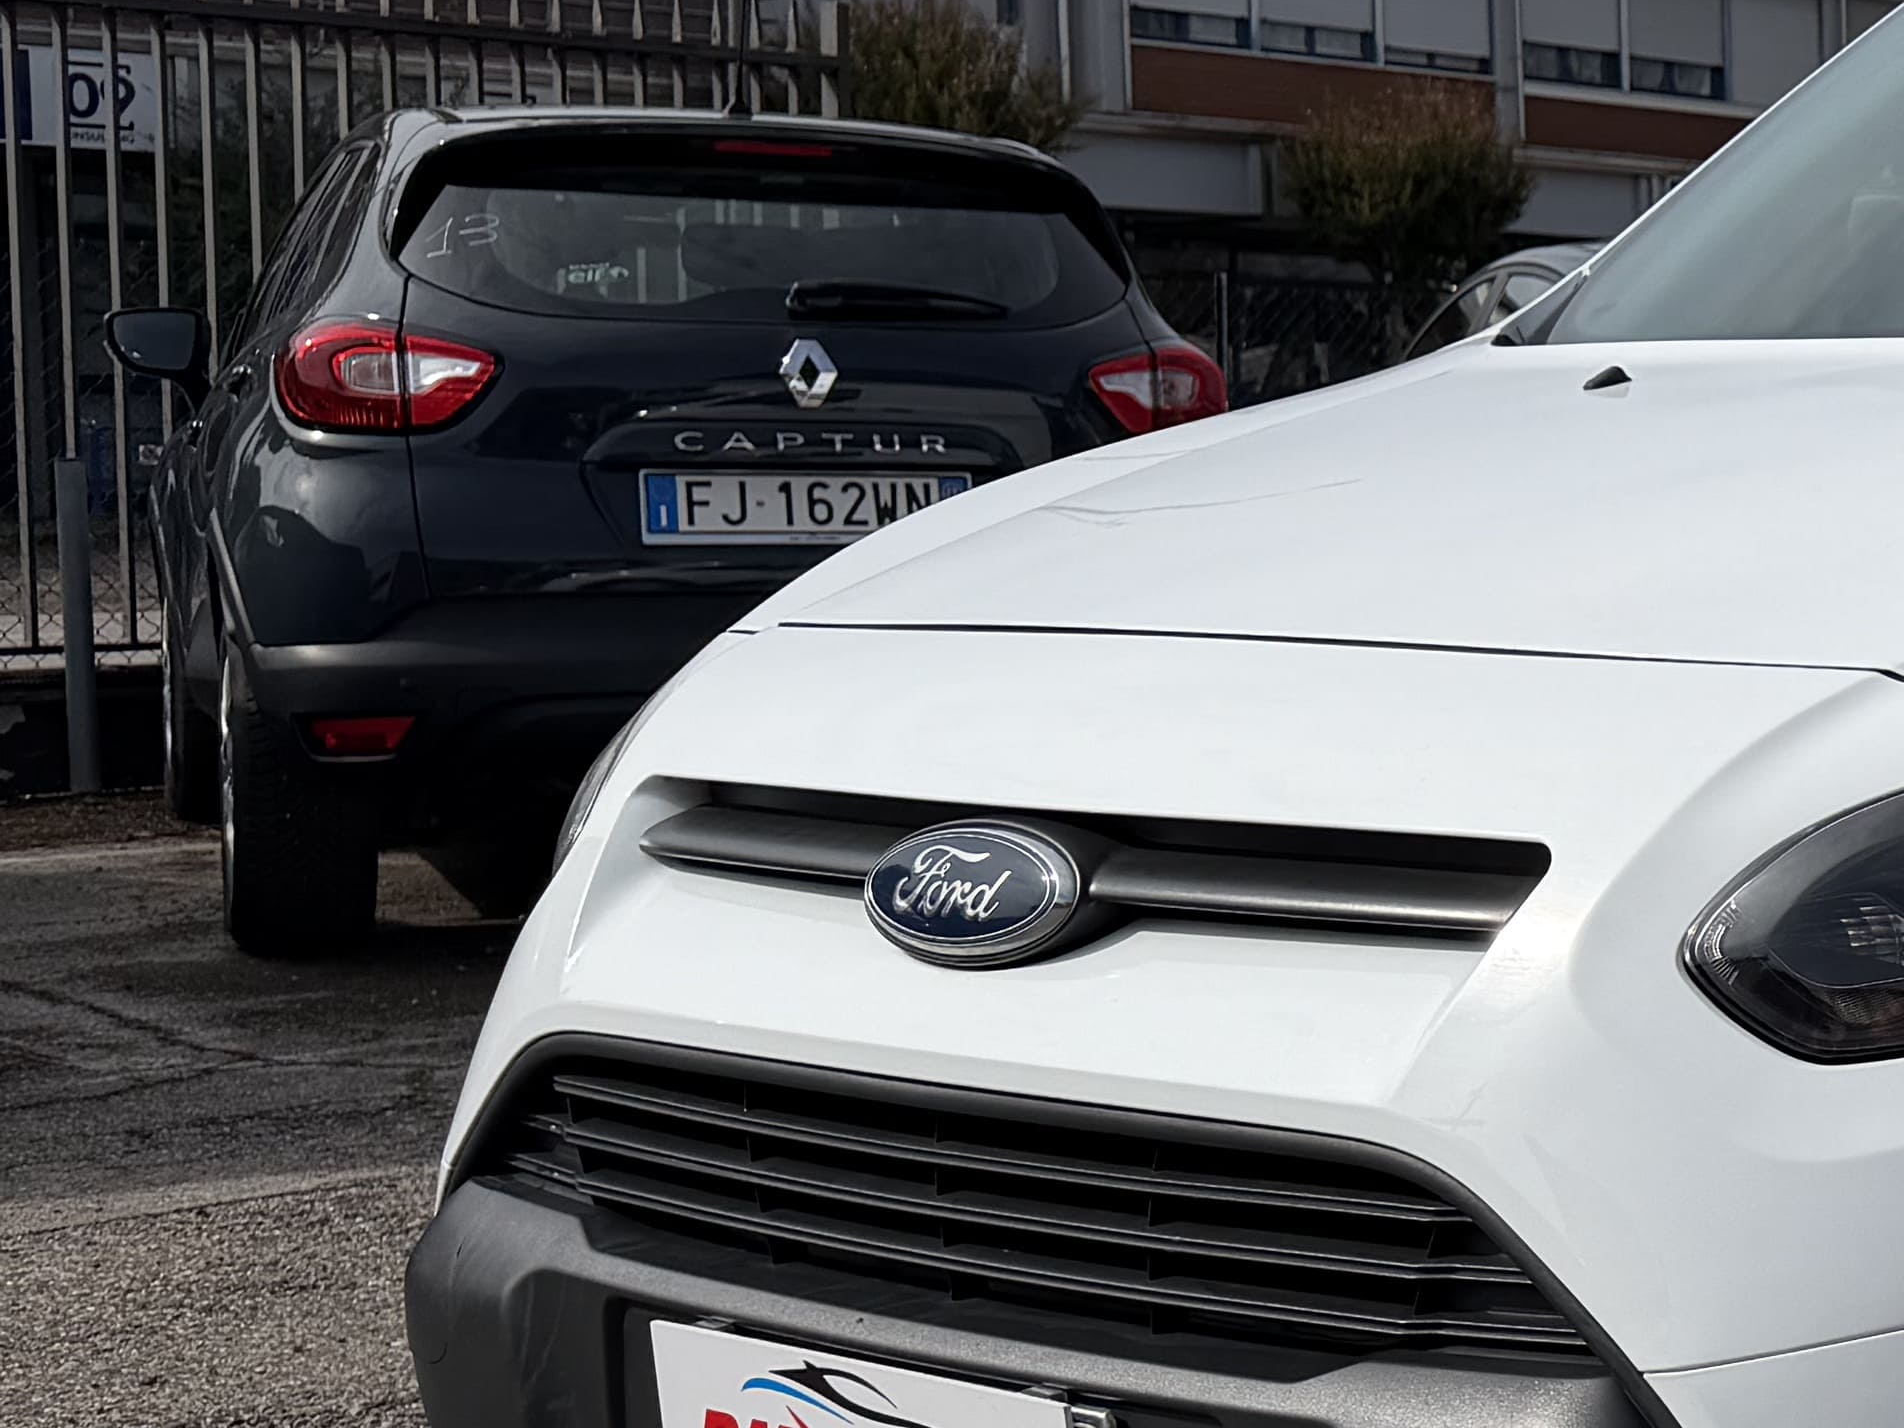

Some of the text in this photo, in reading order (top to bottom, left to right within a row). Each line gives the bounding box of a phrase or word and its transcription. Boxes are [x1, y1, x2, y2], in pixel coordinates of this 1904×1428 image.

[425, 213, 500, 259] 13
[674, 430, 947, 454] CAPTUR
[891, 844, 1013, 923] Ford
